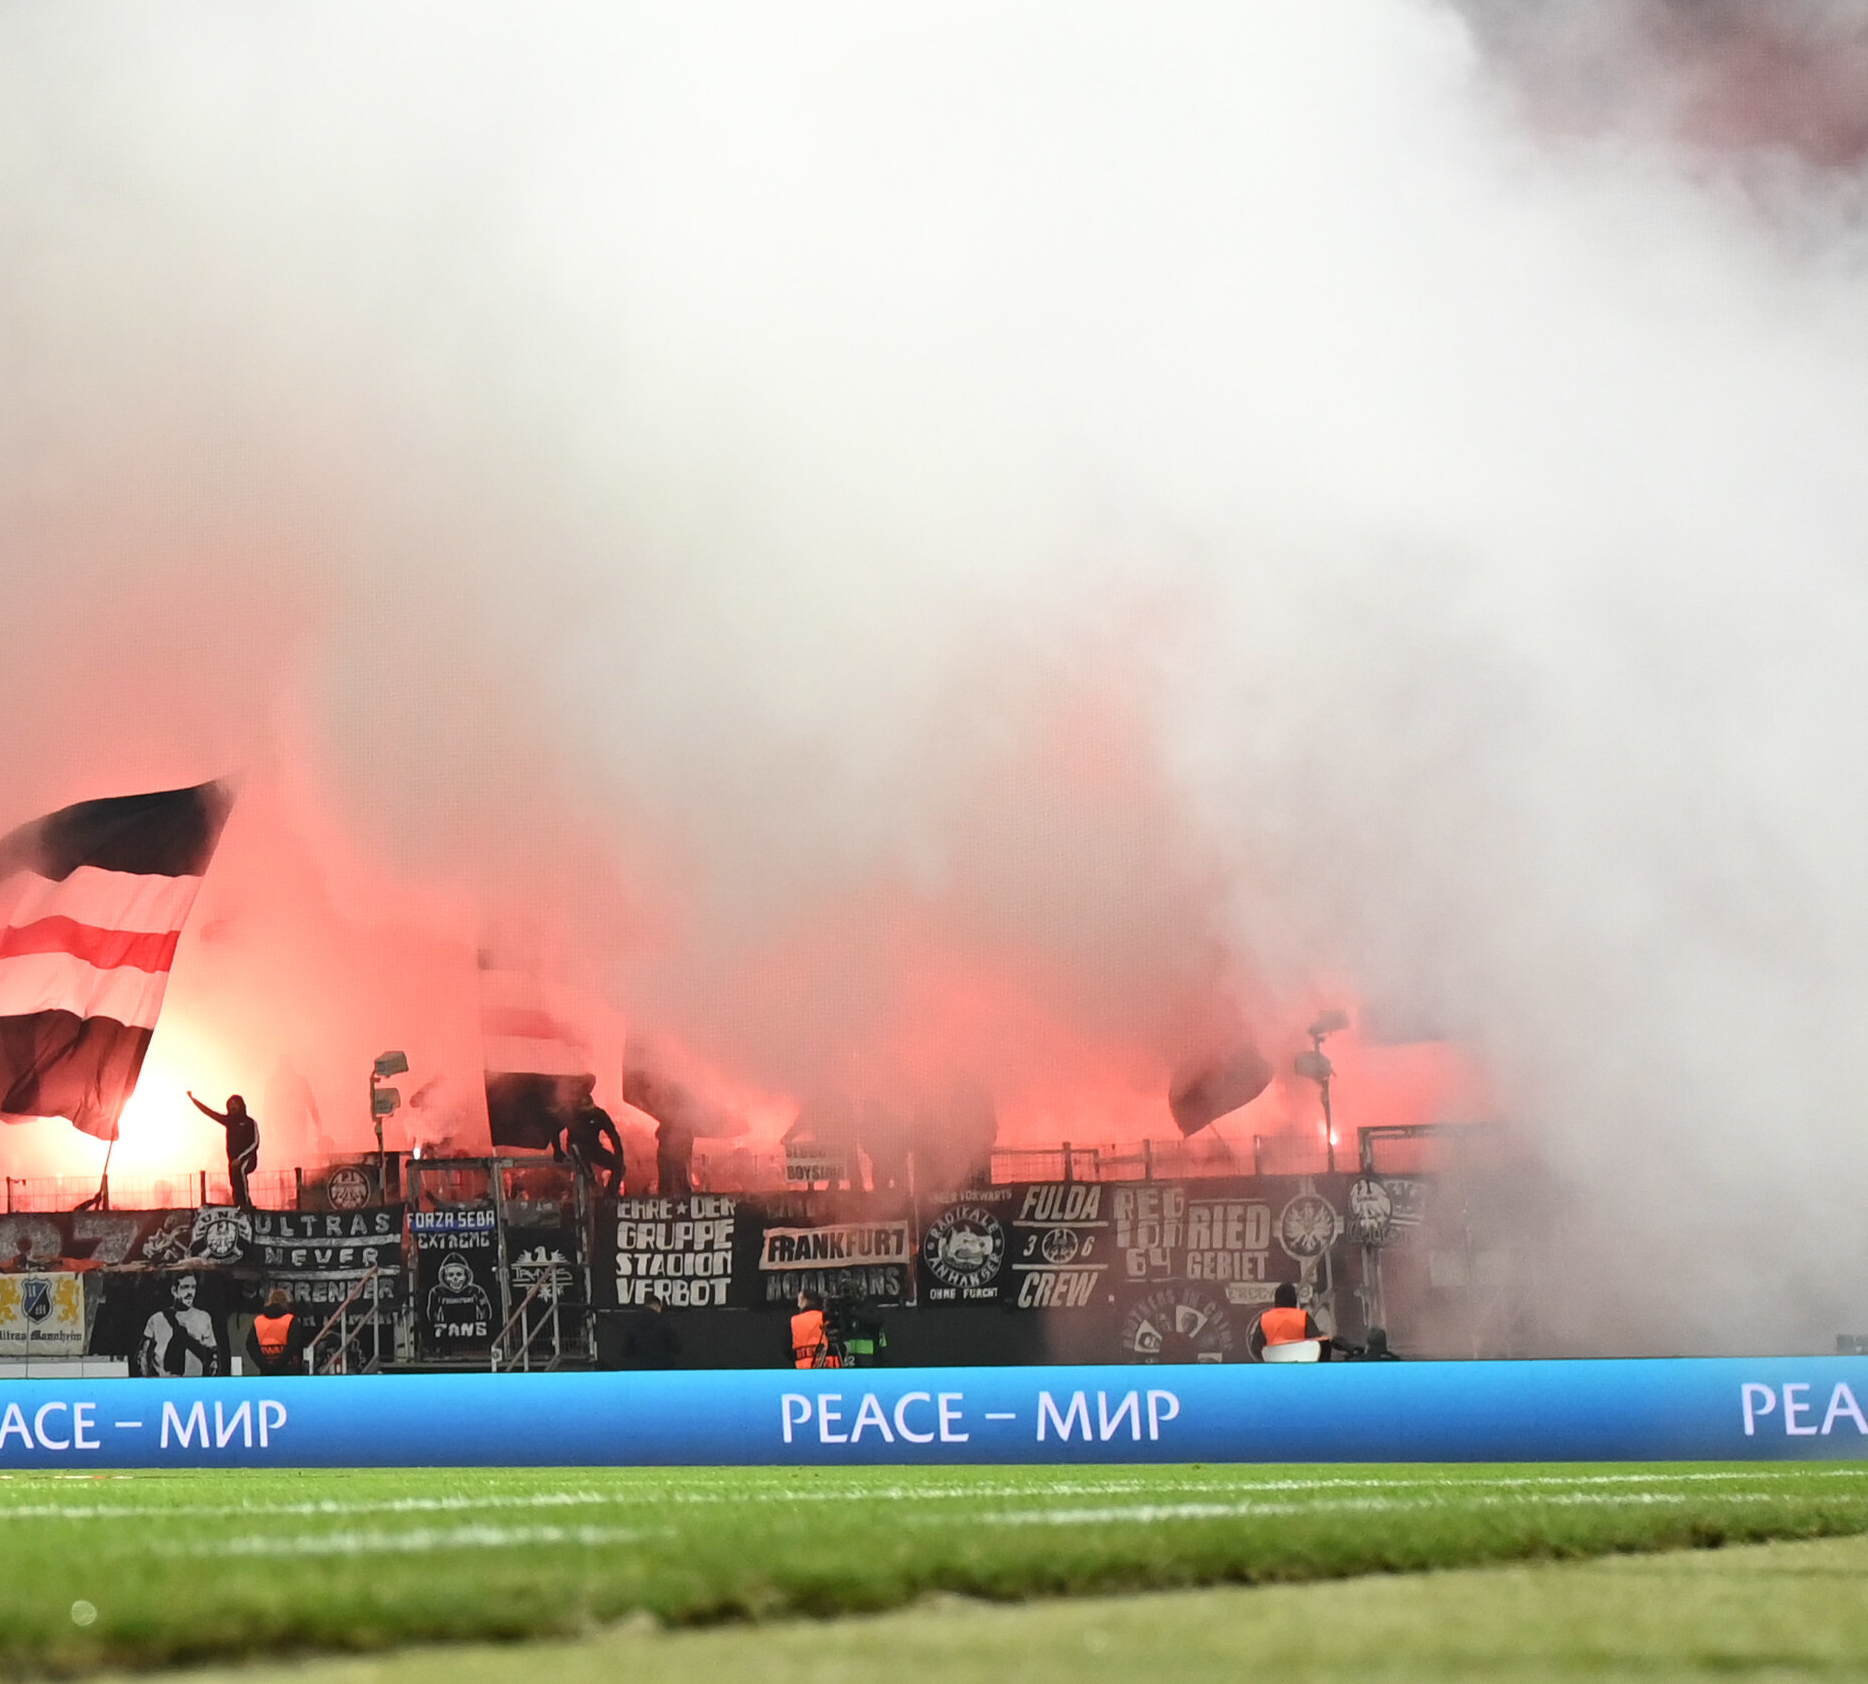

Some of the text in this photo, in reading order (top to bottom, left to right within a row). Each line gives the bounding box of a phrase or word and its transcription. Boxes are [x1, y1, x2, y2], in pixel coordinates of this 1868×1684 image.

[617, 1198, 673, 1220] EHRE
[1019, 1185, 1102, 1220] FULDA
[255, 1212, 391, 1237] ULTRAS
[407, 1209, 495, 1229] FORZA SEBA
[930, 1205, 1000, 1240] RADIKALE
[1187, 1204, 1271, 1251] RIED
[617, 1219, 735, 1251] GRUPPE
[767, 1228, 906, 1263] FRANKFURT
[1023, 1235, 1095, 1257] 3 6
[265, 1246, 379, 1267] NEVER
[615, 1251, 733, 1278] STADION
[1186, 1251, 1269, 1281] GEBIET
[615, 1277, 732, 1307] VERBOT
[930, 1287, 999, 1300] OHNE FURCHT
[1017, 1272, 1098, 1309] CREW
[434, 1321, 488, 1338] FANS
[781, 1392, 969, 1443] PEACE
[1741, 1383, 1868, 1435] PEA
